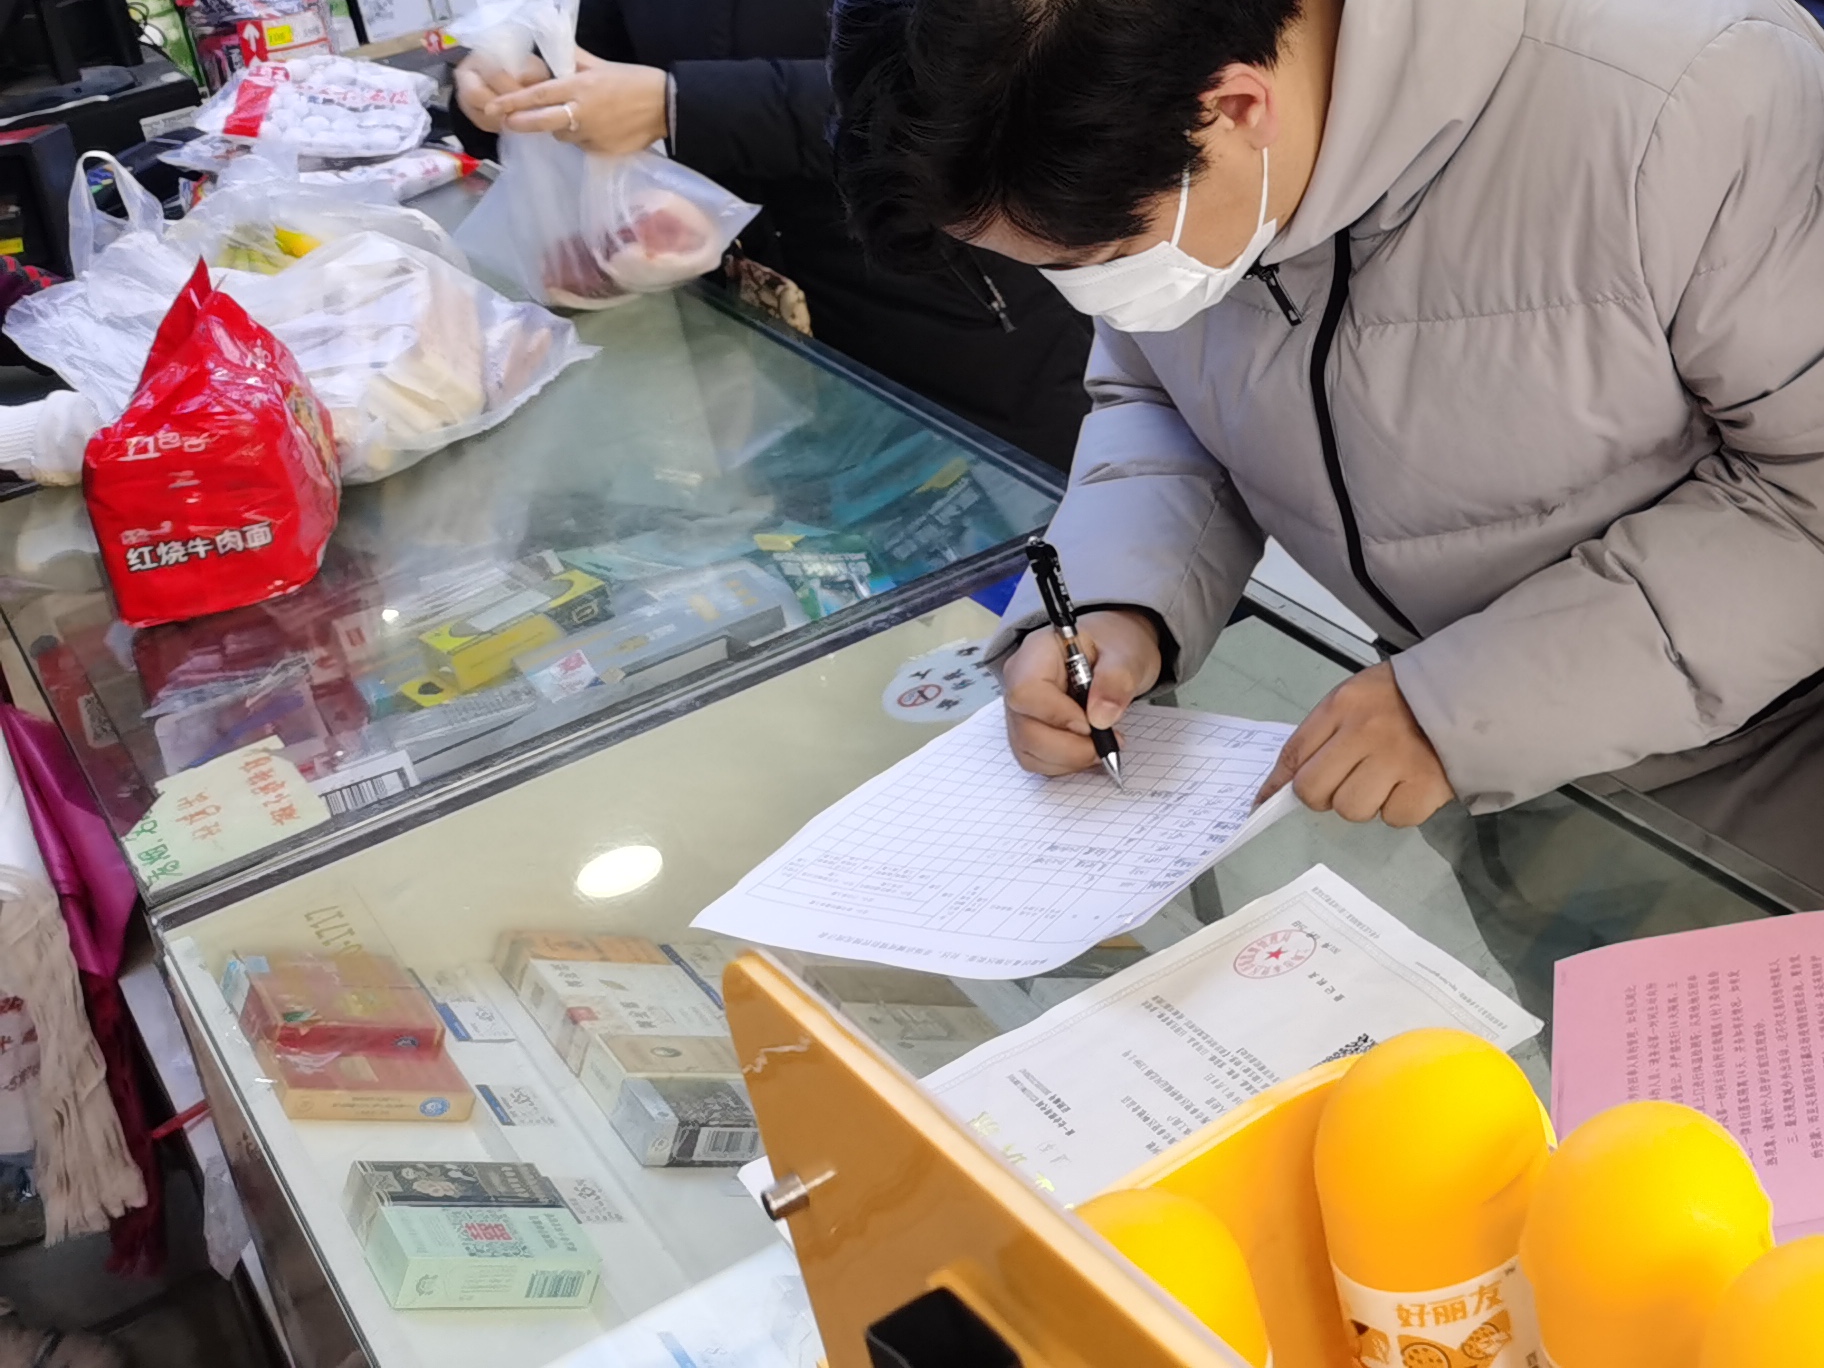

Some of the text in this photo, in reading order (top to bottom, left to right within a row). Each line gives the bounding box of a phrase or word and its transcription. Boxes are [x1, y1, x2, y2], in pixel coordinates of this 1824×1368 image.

[126, 521, 274, 572] 红烧牛肉面
[1396, 1281, 1504, 1329] 好丽友
